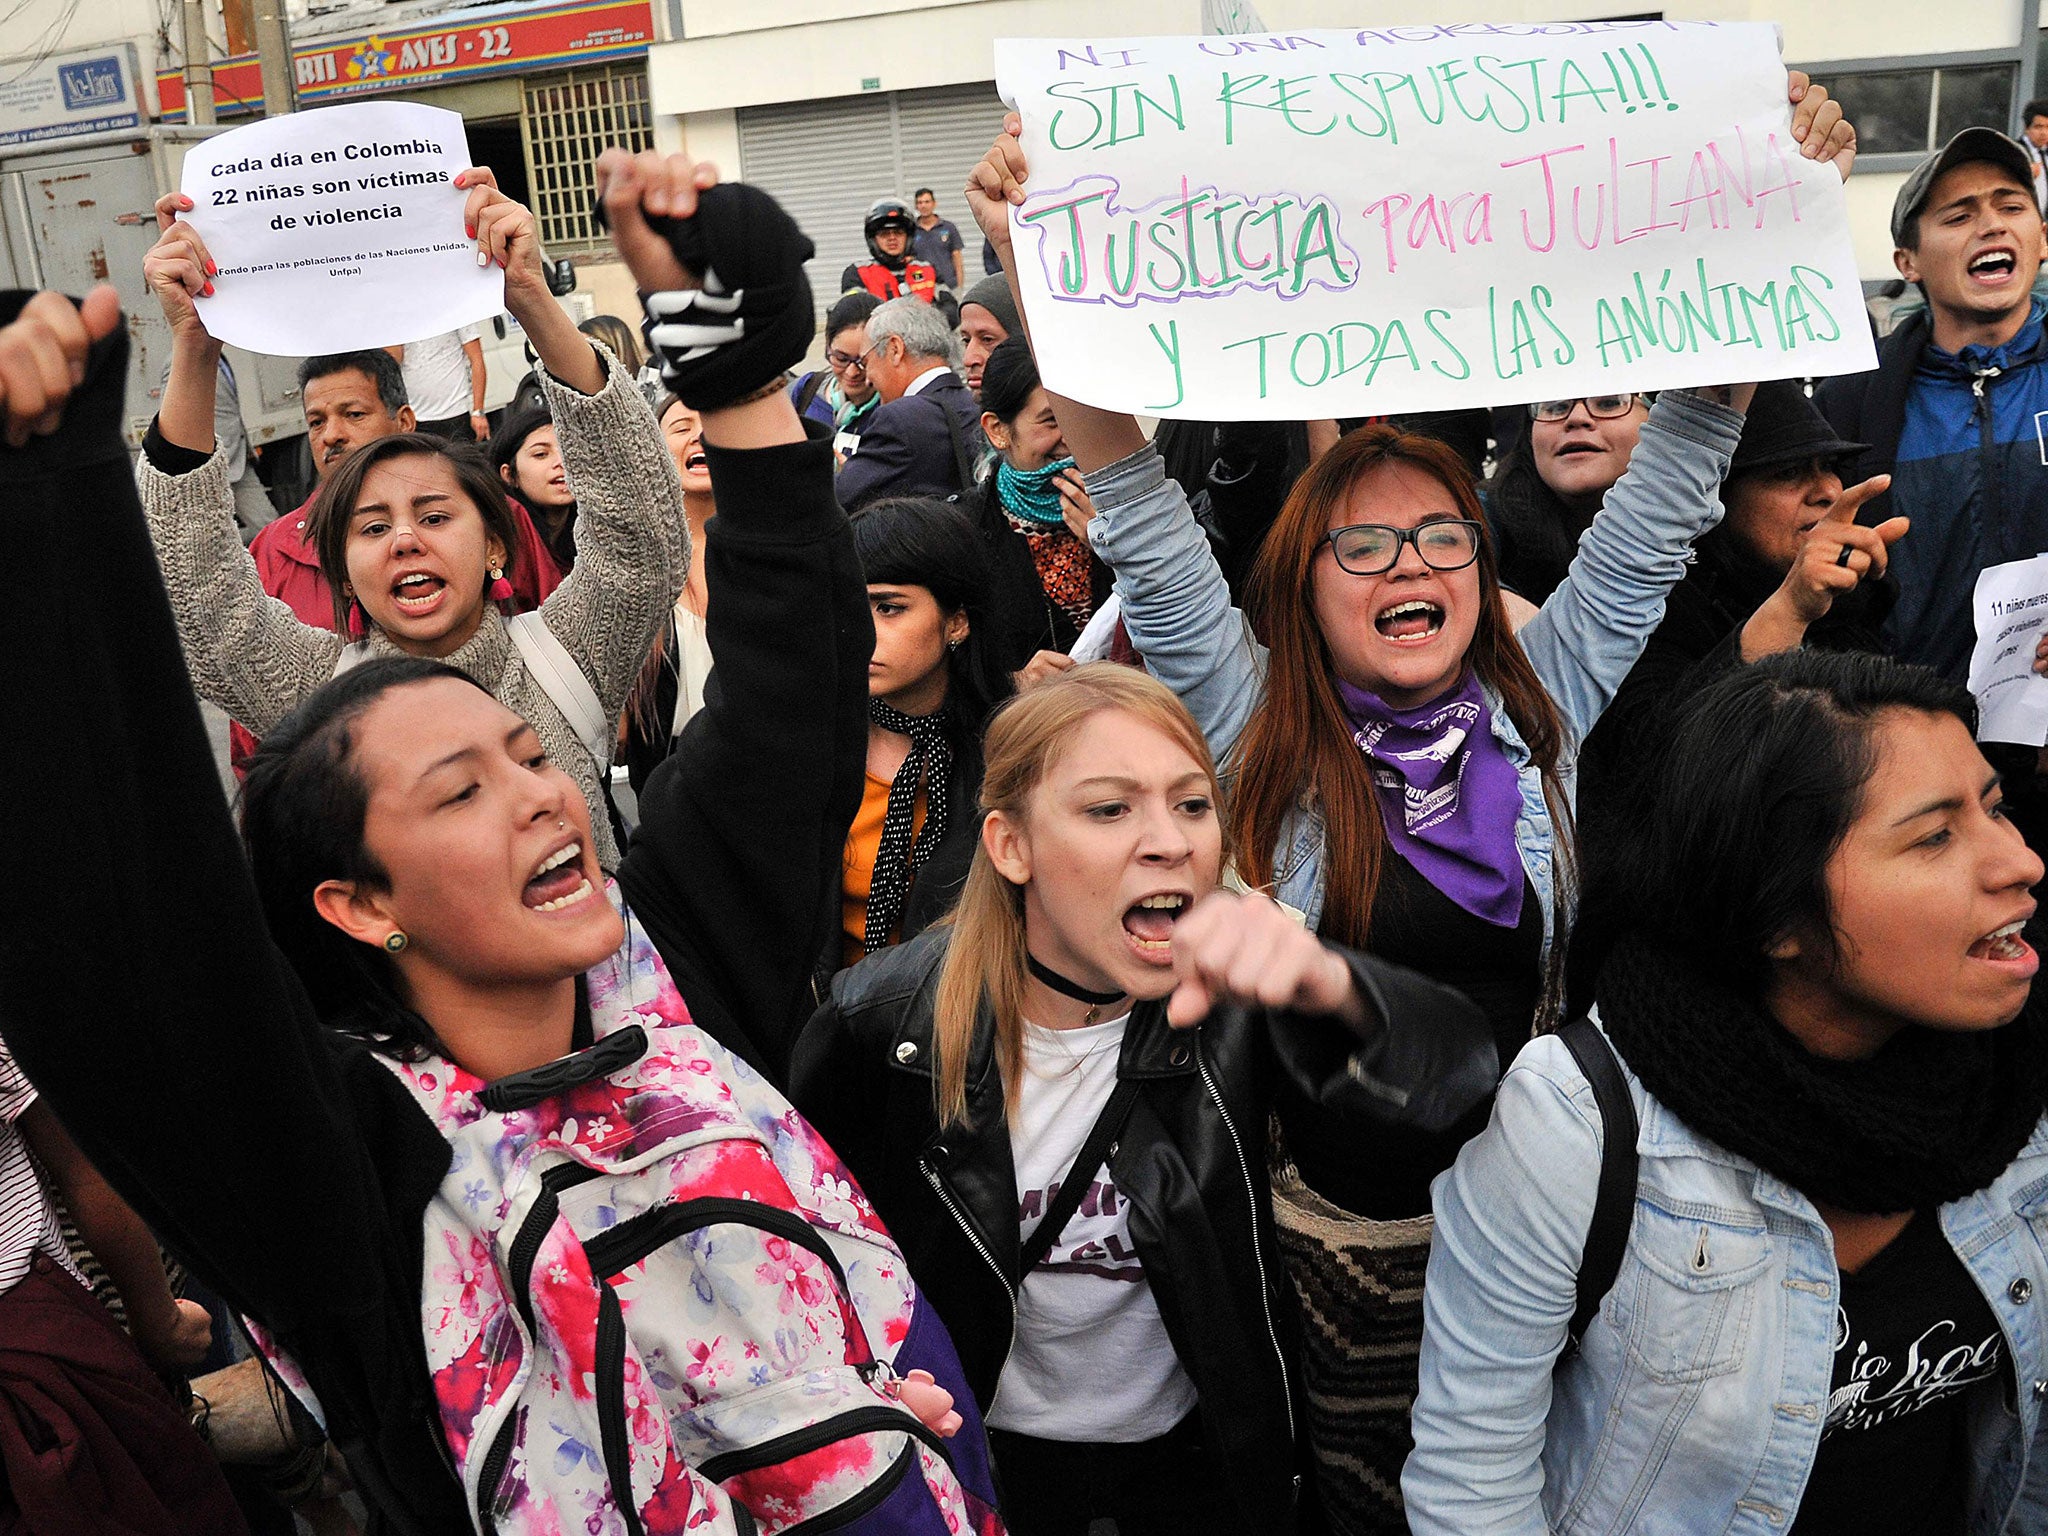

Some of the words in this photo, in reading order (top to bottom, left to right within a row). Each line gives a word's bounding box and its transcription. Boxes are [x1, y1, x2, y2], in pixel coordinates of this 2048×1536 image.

[294, 53, 338, 86] RTI
[399, 33, 457, 71] AVES
[477, 27, 513, 60] 22
[1057, 45, 1147, 71] NI
[1198, 36, 1326, 56] UNA
[1046, 73, 1186, 151] SIN
[1216, 42, 1681, 146] RESPUESTA!!!
[109, 117, 134, 128] casa
[210, 157, 264, 177] Cada
[269, 150, 304, 169] día
[310, 150, 337, 164] en
[343, 138, 444, 161] Colombia
[211, 188, 240, 206] 22
[244, 181, 305, 203] niñas
[311, 180, 351, 196] son
[356, 168, 450, 190] víctimas
[270, 213, 297, 231] de
[302, 203, 403, 228] violencia
[1361, 192, 1494, 274] para
[251, 263, 274, 274] para
[276, 261, 291, 269] las
[293, 255, 352, 269] poblaciones
[354, 252, 366, 261] de
[368, 251, 383, 259] las
[386, 246, 431, 257] Naciones
[432, 242, 470, 252] Unidas,
[329, 266, 362, 277] Unfpa)
[1222, 309, 1471, 399] TODAS
[1488, 284, 1576, 380] LAS
[1595, 258, 1842, 368] ANÓNIMAS
[1991, 600, 2004, 617] 11
